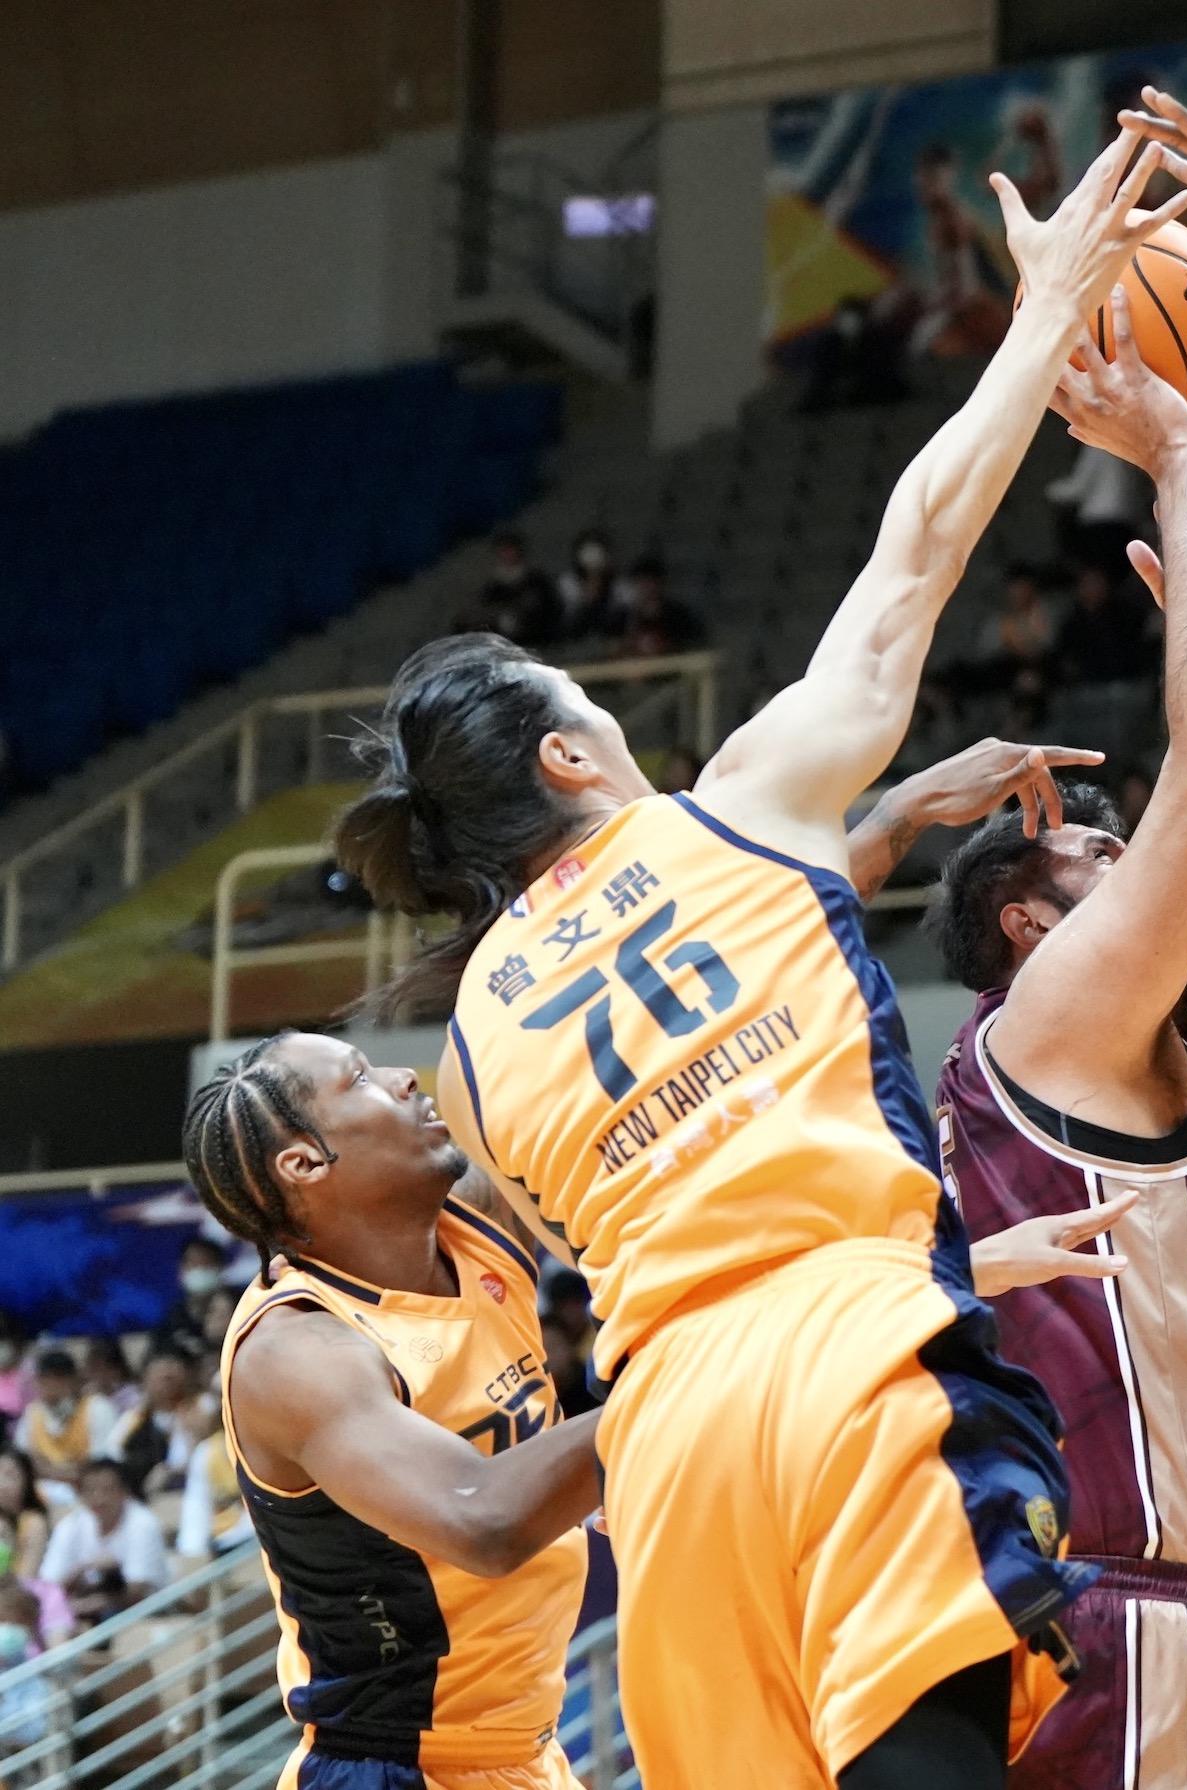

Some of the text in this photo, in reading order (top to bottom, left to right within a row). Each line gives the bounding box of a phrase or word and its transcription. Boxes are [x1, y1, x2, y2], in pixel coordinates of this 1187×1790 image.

[487, 860, 661, 1006] 曾文鼎
[520, 899, 741, 1104] 76
[595, 1005, 801, 1175] NEW TAIPEI CITY
[485, 1353, 538, 1403] CTBC
